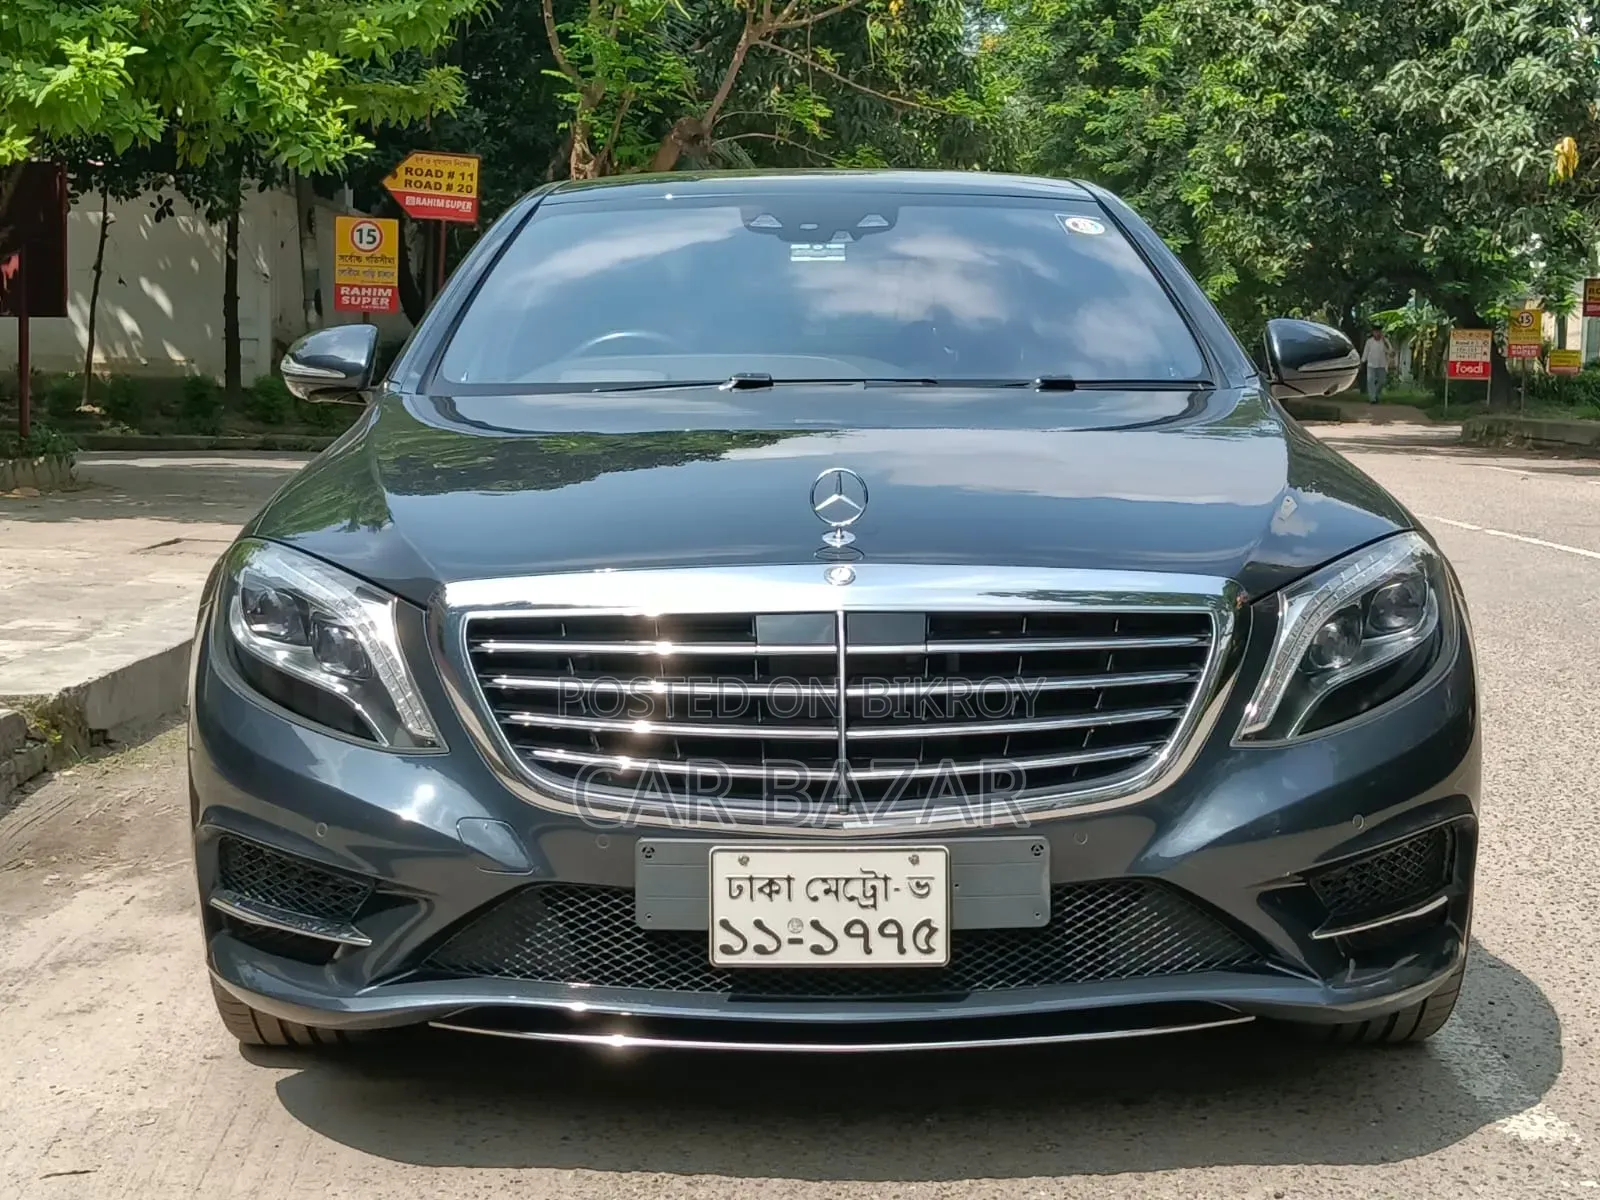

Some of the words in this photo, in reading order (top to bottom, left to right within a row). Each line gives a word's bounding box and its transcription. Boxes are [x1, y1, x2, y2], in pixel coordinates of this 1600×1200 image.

[405, 167, 444, 179] ROAD
[447, 170, 455, 180] #
[459, 171, 474, 182] 11
[404, 179, 442, 191] ROAD
[446, 182, 454, 192] #
[457, 184, 473, 194] 20
[416, 197, 444, 208] RAHIM
[444, 200, 473, 210] SUPER
[356, 228, 377, 245] 15
[340, 286, 392, 297] RAHIM
[341, 296, 390, 306] SUPER
[1520, 315, 1531, 324] 15
[1456, 362, 1484, 374] foodi
[726, 873, 796, 903] ঢাকা
[718, 917, 940, 956] ১১-১৭৭৫
